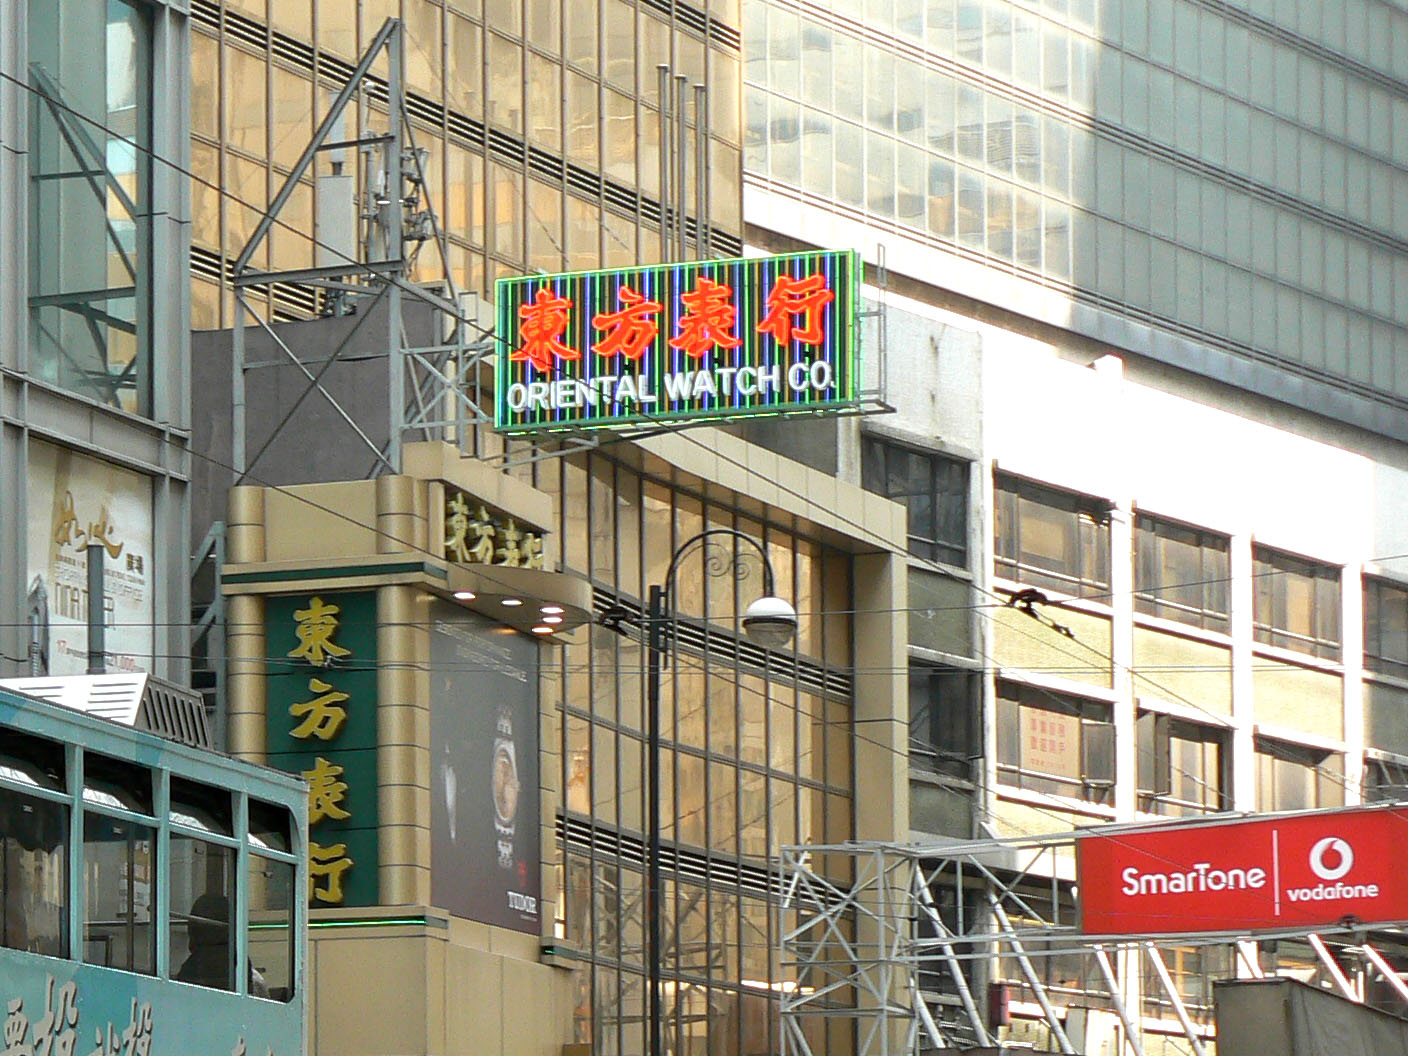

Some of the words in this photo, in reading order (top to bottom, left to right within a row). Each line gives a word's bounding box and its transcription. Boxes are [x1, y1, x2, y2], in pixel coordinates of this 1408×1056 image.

[508, 274, 835, 373] 東方表行
[506, 374, 658, 412] ORIENTAL
[664, 364, 781, 401] WATCH
[788, 360, 838, 392] CO.
[1122, 862, 1266, 896] SmarTone
[1287, 883, 1379, 902] vodafone
